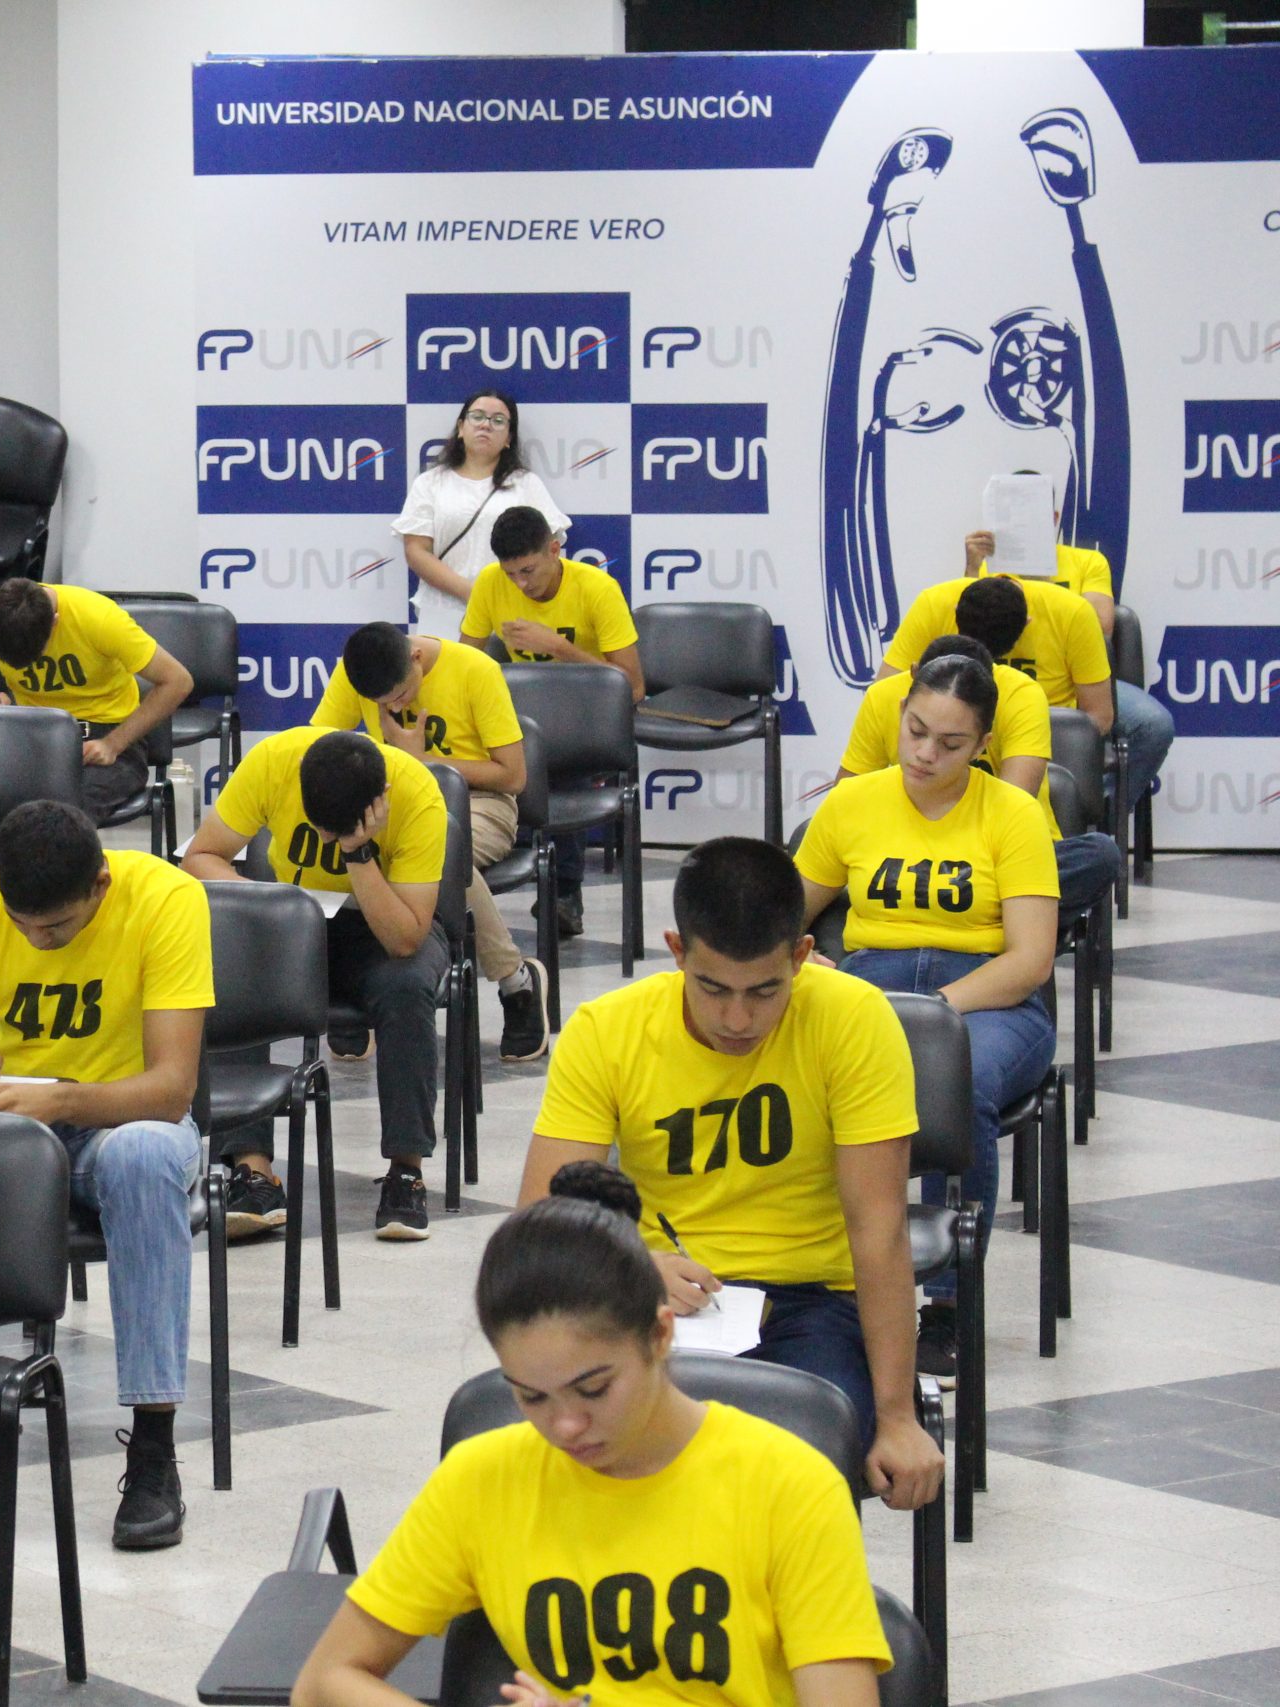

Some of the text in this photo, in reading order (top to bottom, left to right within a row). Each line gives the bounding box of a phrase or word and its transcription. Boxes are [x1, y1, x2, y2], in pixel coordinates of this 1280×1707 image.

[216, 91, 773, 125] UNIVERSIDAD NACIONAL DE ASUNCIÓN
[323, 218, 665, 243] VITAM IMPENDERE VERO
[19, 652, 87, 693] 320
[867, 857, 975, 914] 413
[653, 1082, 794, 1176] 170
[523, 1566, 731, 1691] 098
